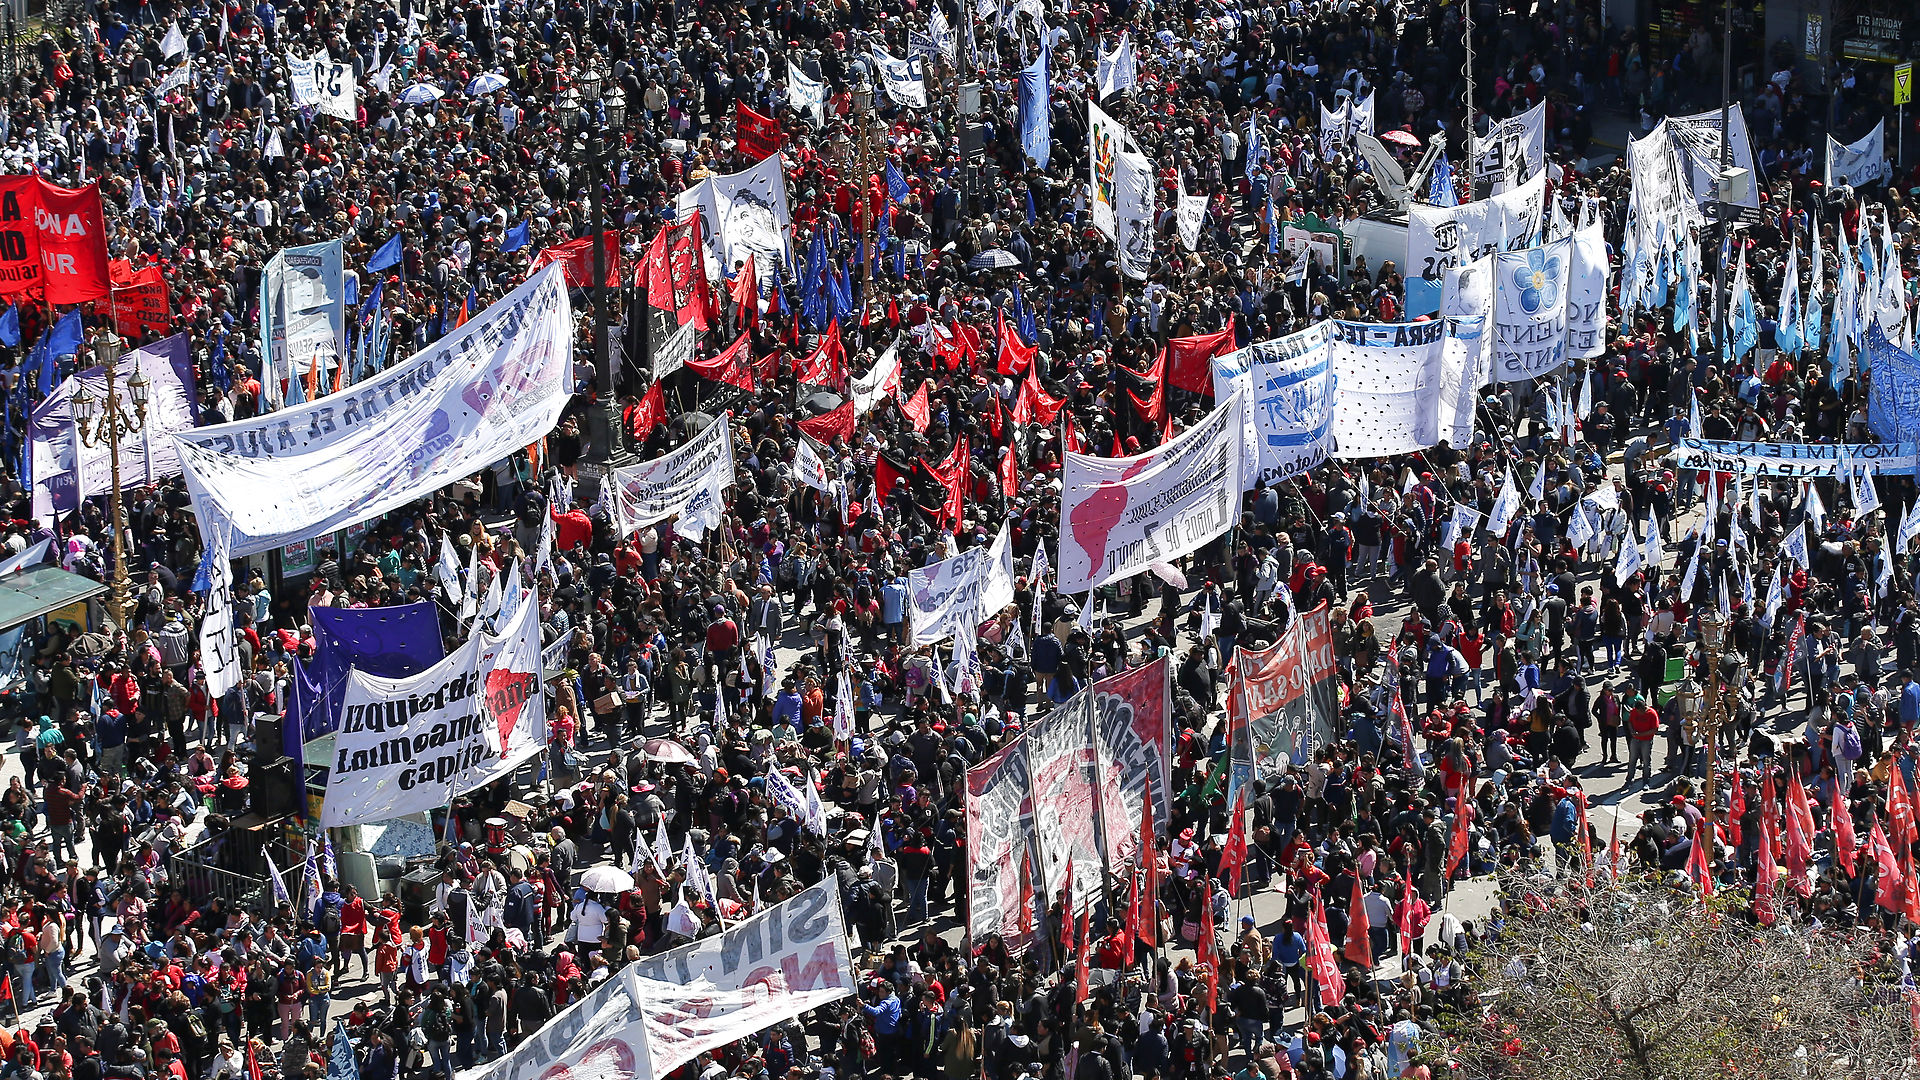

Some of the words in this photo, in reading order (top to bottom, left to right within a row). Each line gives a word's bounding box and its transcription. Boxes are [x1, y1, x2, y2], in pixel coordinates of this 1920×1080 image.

[1857, 15, 1870, 26] IT'S
[1872, 17, 1902, 30] MONDAY
[1860, 25, 1870, 37] I'M
[1882, 28, 1900, 40] LOVE
